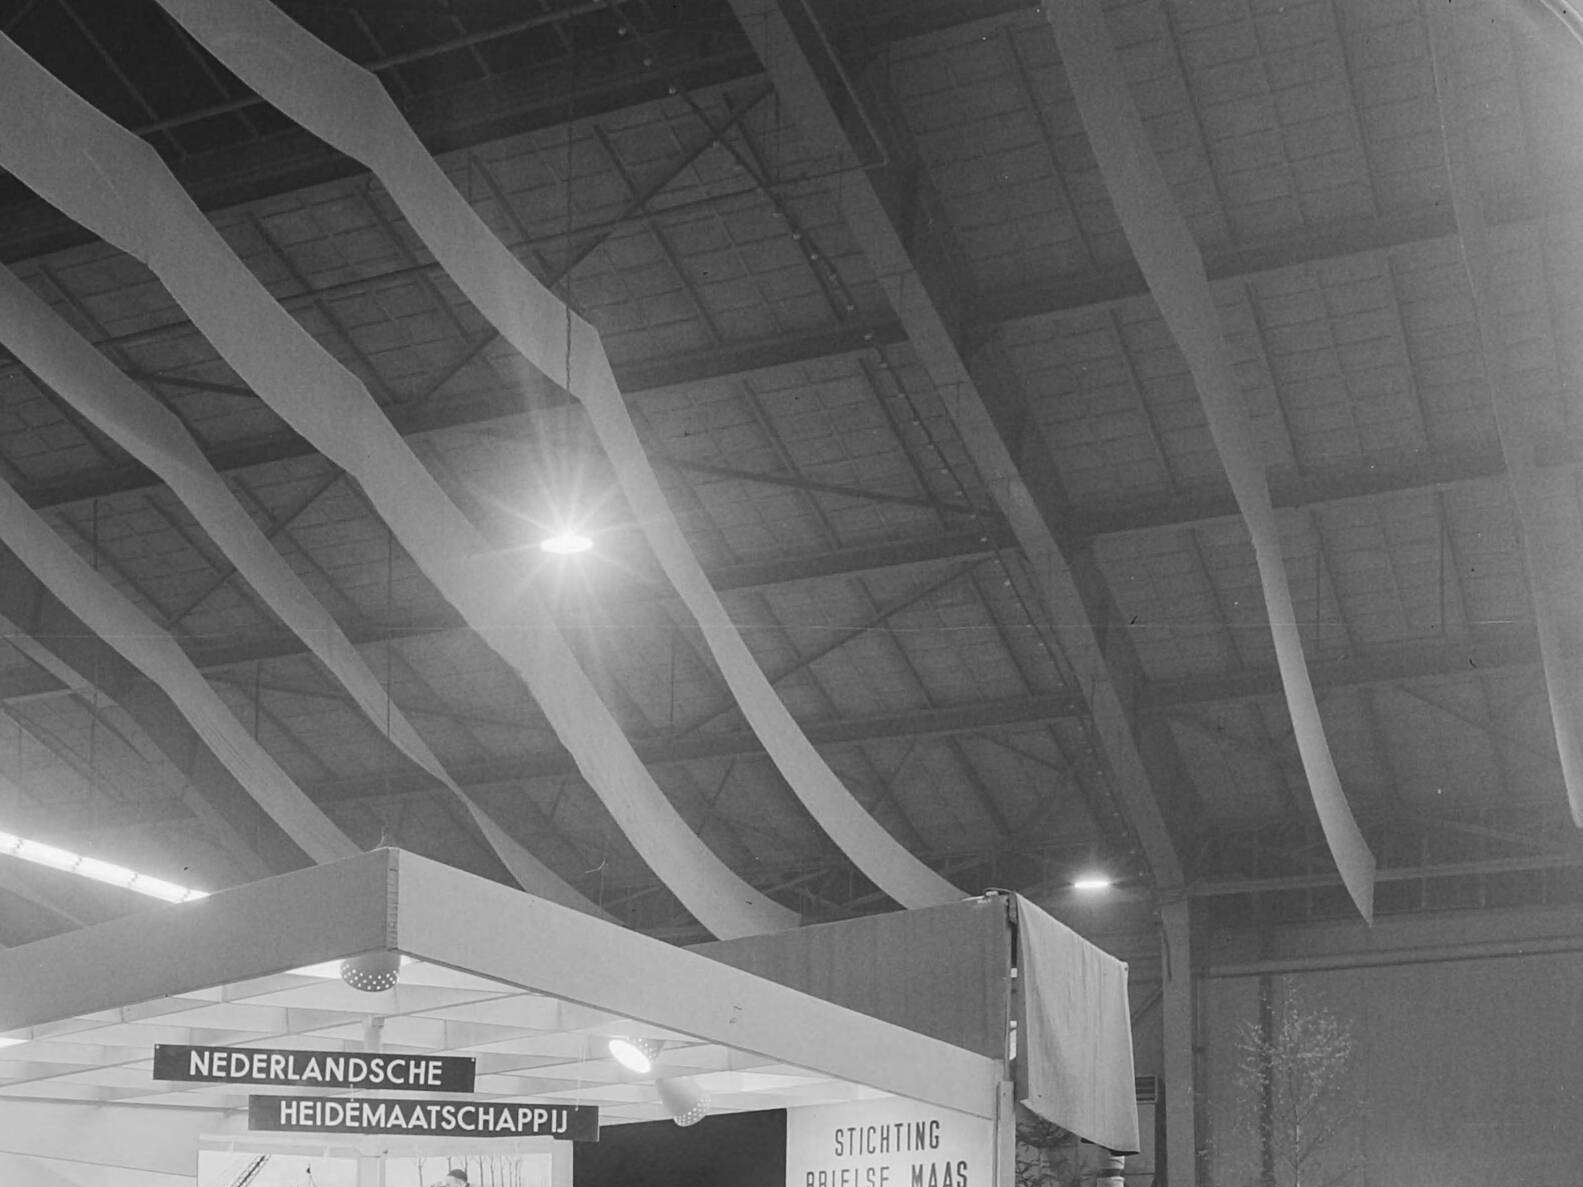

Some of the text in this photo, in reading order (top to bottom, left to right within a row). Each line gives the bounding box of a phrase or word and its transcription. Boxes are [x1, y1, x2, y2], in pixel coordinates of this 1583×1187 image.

[189, 1050, 443, 1086] NEDERLANDSCHE
[279, 1099, 568, 1134] HEIDEMAATSCHAPPIJ
[835, 1120, 940, 1157] STICHTING
